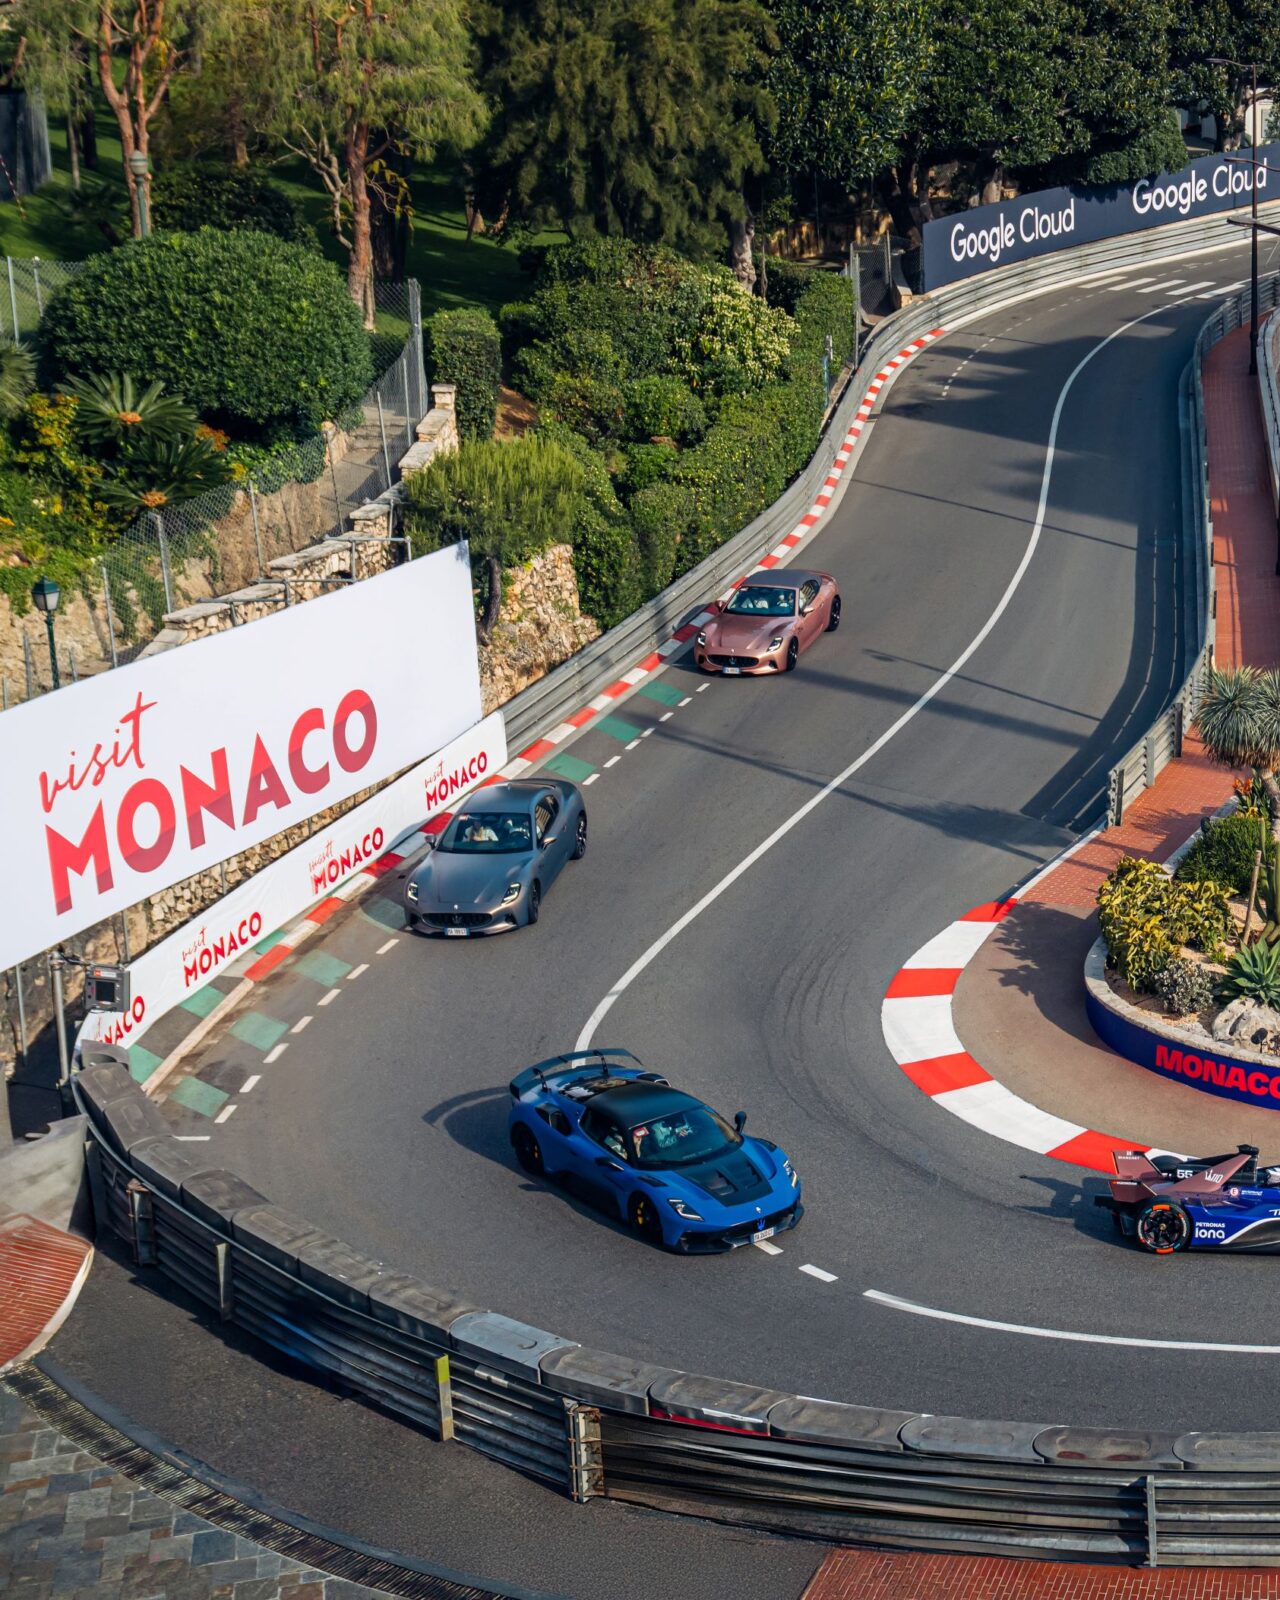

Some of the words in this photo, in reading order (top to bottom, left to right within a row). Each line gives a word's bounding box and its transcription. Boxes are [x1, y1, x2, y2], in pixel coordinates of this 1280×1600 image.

[1132, 171, 1207, 215] Google
[1212, 158, 1268, 197] Cloud
[951, 213, 1015, 262] Google
[1020, 198, 1075, 243] Cloud
[39, 691, 158, 813] visit
[426, 751, 487, 811] MONACO
[45, 689, 378, 916] MONACO
[311, 827, 384, 895] MONACO
[184, 912, 262, 987] MONACO
[1177, 1169, 1193, 1179] 55
